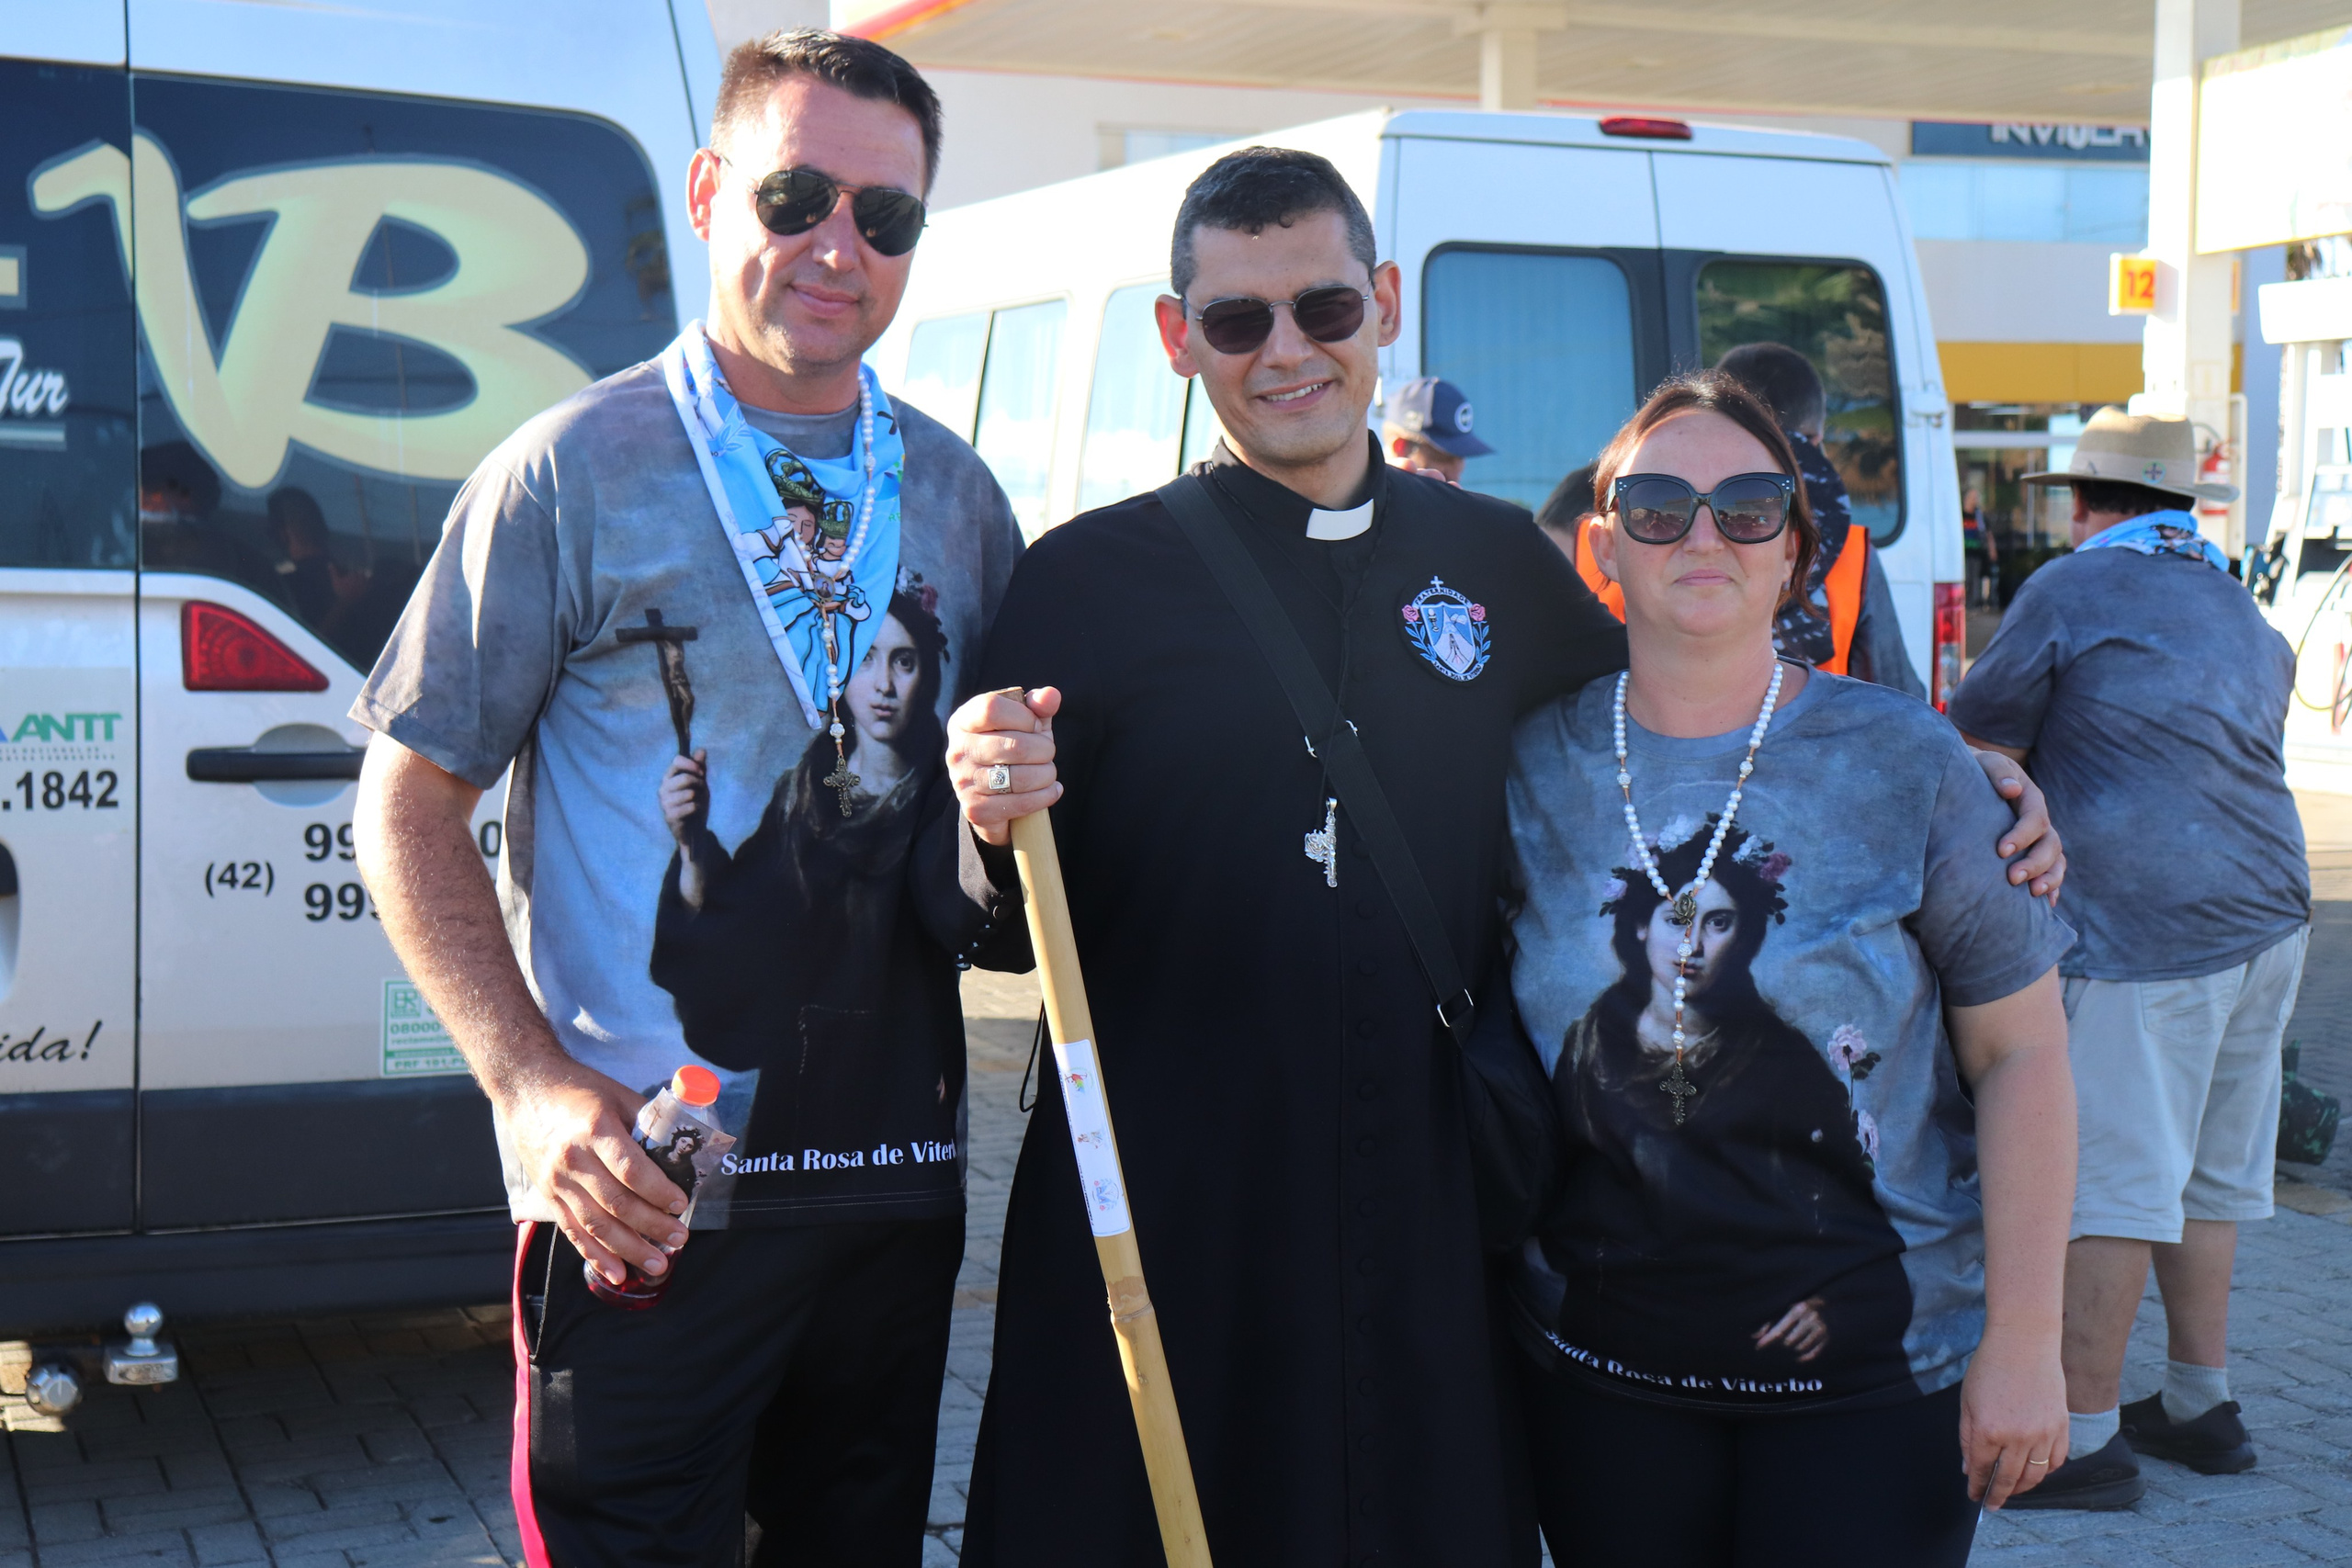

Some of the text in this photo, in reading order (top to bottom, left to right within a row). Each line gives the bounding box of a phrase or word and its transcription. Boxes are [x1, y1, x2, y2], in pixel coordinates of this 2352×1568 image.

[2127, 271, 2154, 299] 12
[12, 713, 121, 742] ANTT
[205, 861, 275, 897] (42)
[720, 1151, 796, 1176] Santa
[803, 1148, 865, 1170] Rosa
[873, 1143, 905, 1166] de
[1608, 1359, 1673, 1387] Rosa
[1681, 1374, 1713, 1390] de
[1720, 1376, 1824, 1393] Viterbo
